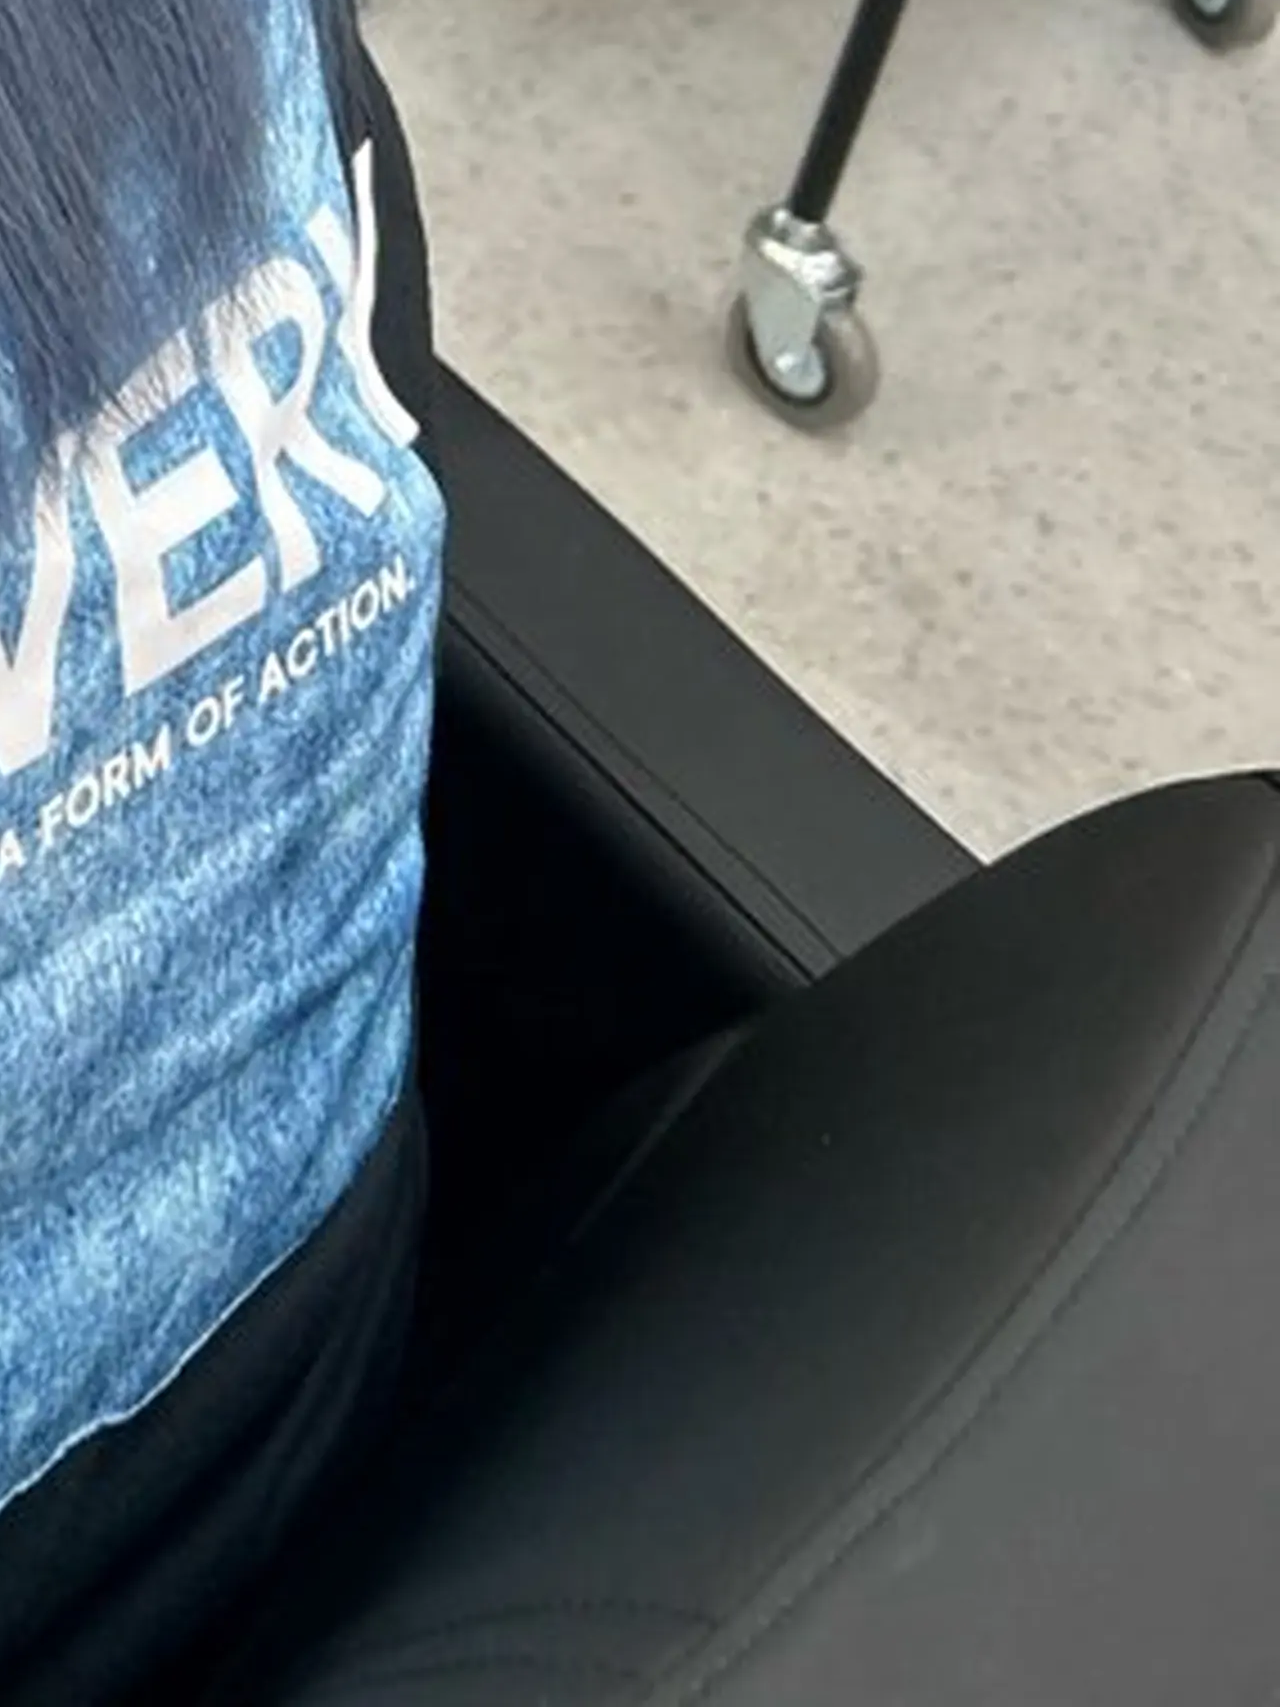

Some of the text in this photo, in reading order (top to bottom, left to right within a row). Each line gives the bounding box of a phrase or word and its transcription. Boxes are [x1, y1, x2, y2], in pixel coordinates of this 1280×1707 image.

[40, 723, 172, 849] FORM
[186, 674, 246, 746] OF
[258, 554, 418, 703] ACTION.
